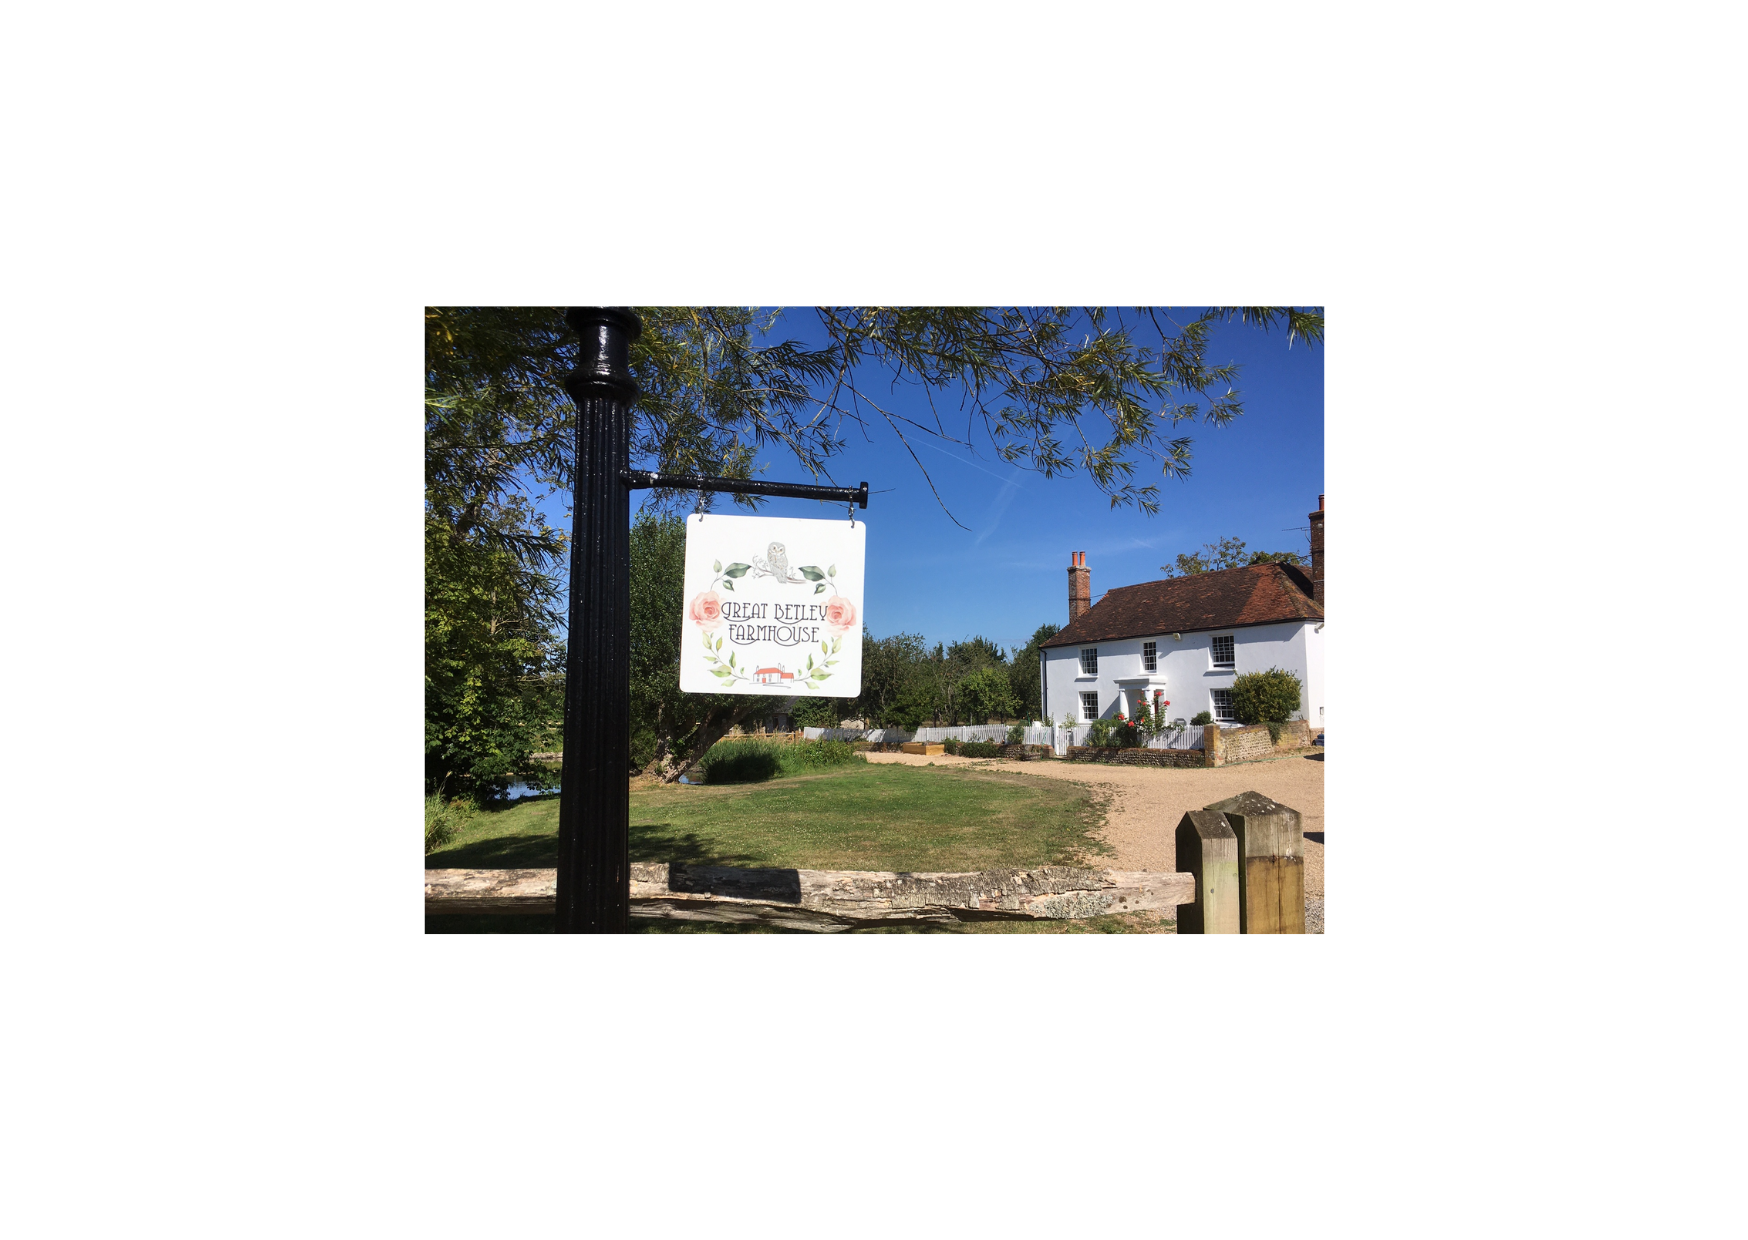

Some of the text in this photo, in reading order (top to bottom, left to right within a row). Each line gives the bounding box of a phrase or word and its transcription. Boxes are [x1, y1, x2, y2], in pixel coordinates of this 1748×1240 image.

[721, 602, 828, 624] GREAT BETLEY
[729, 624, 820, 646] FARMHOUSE
